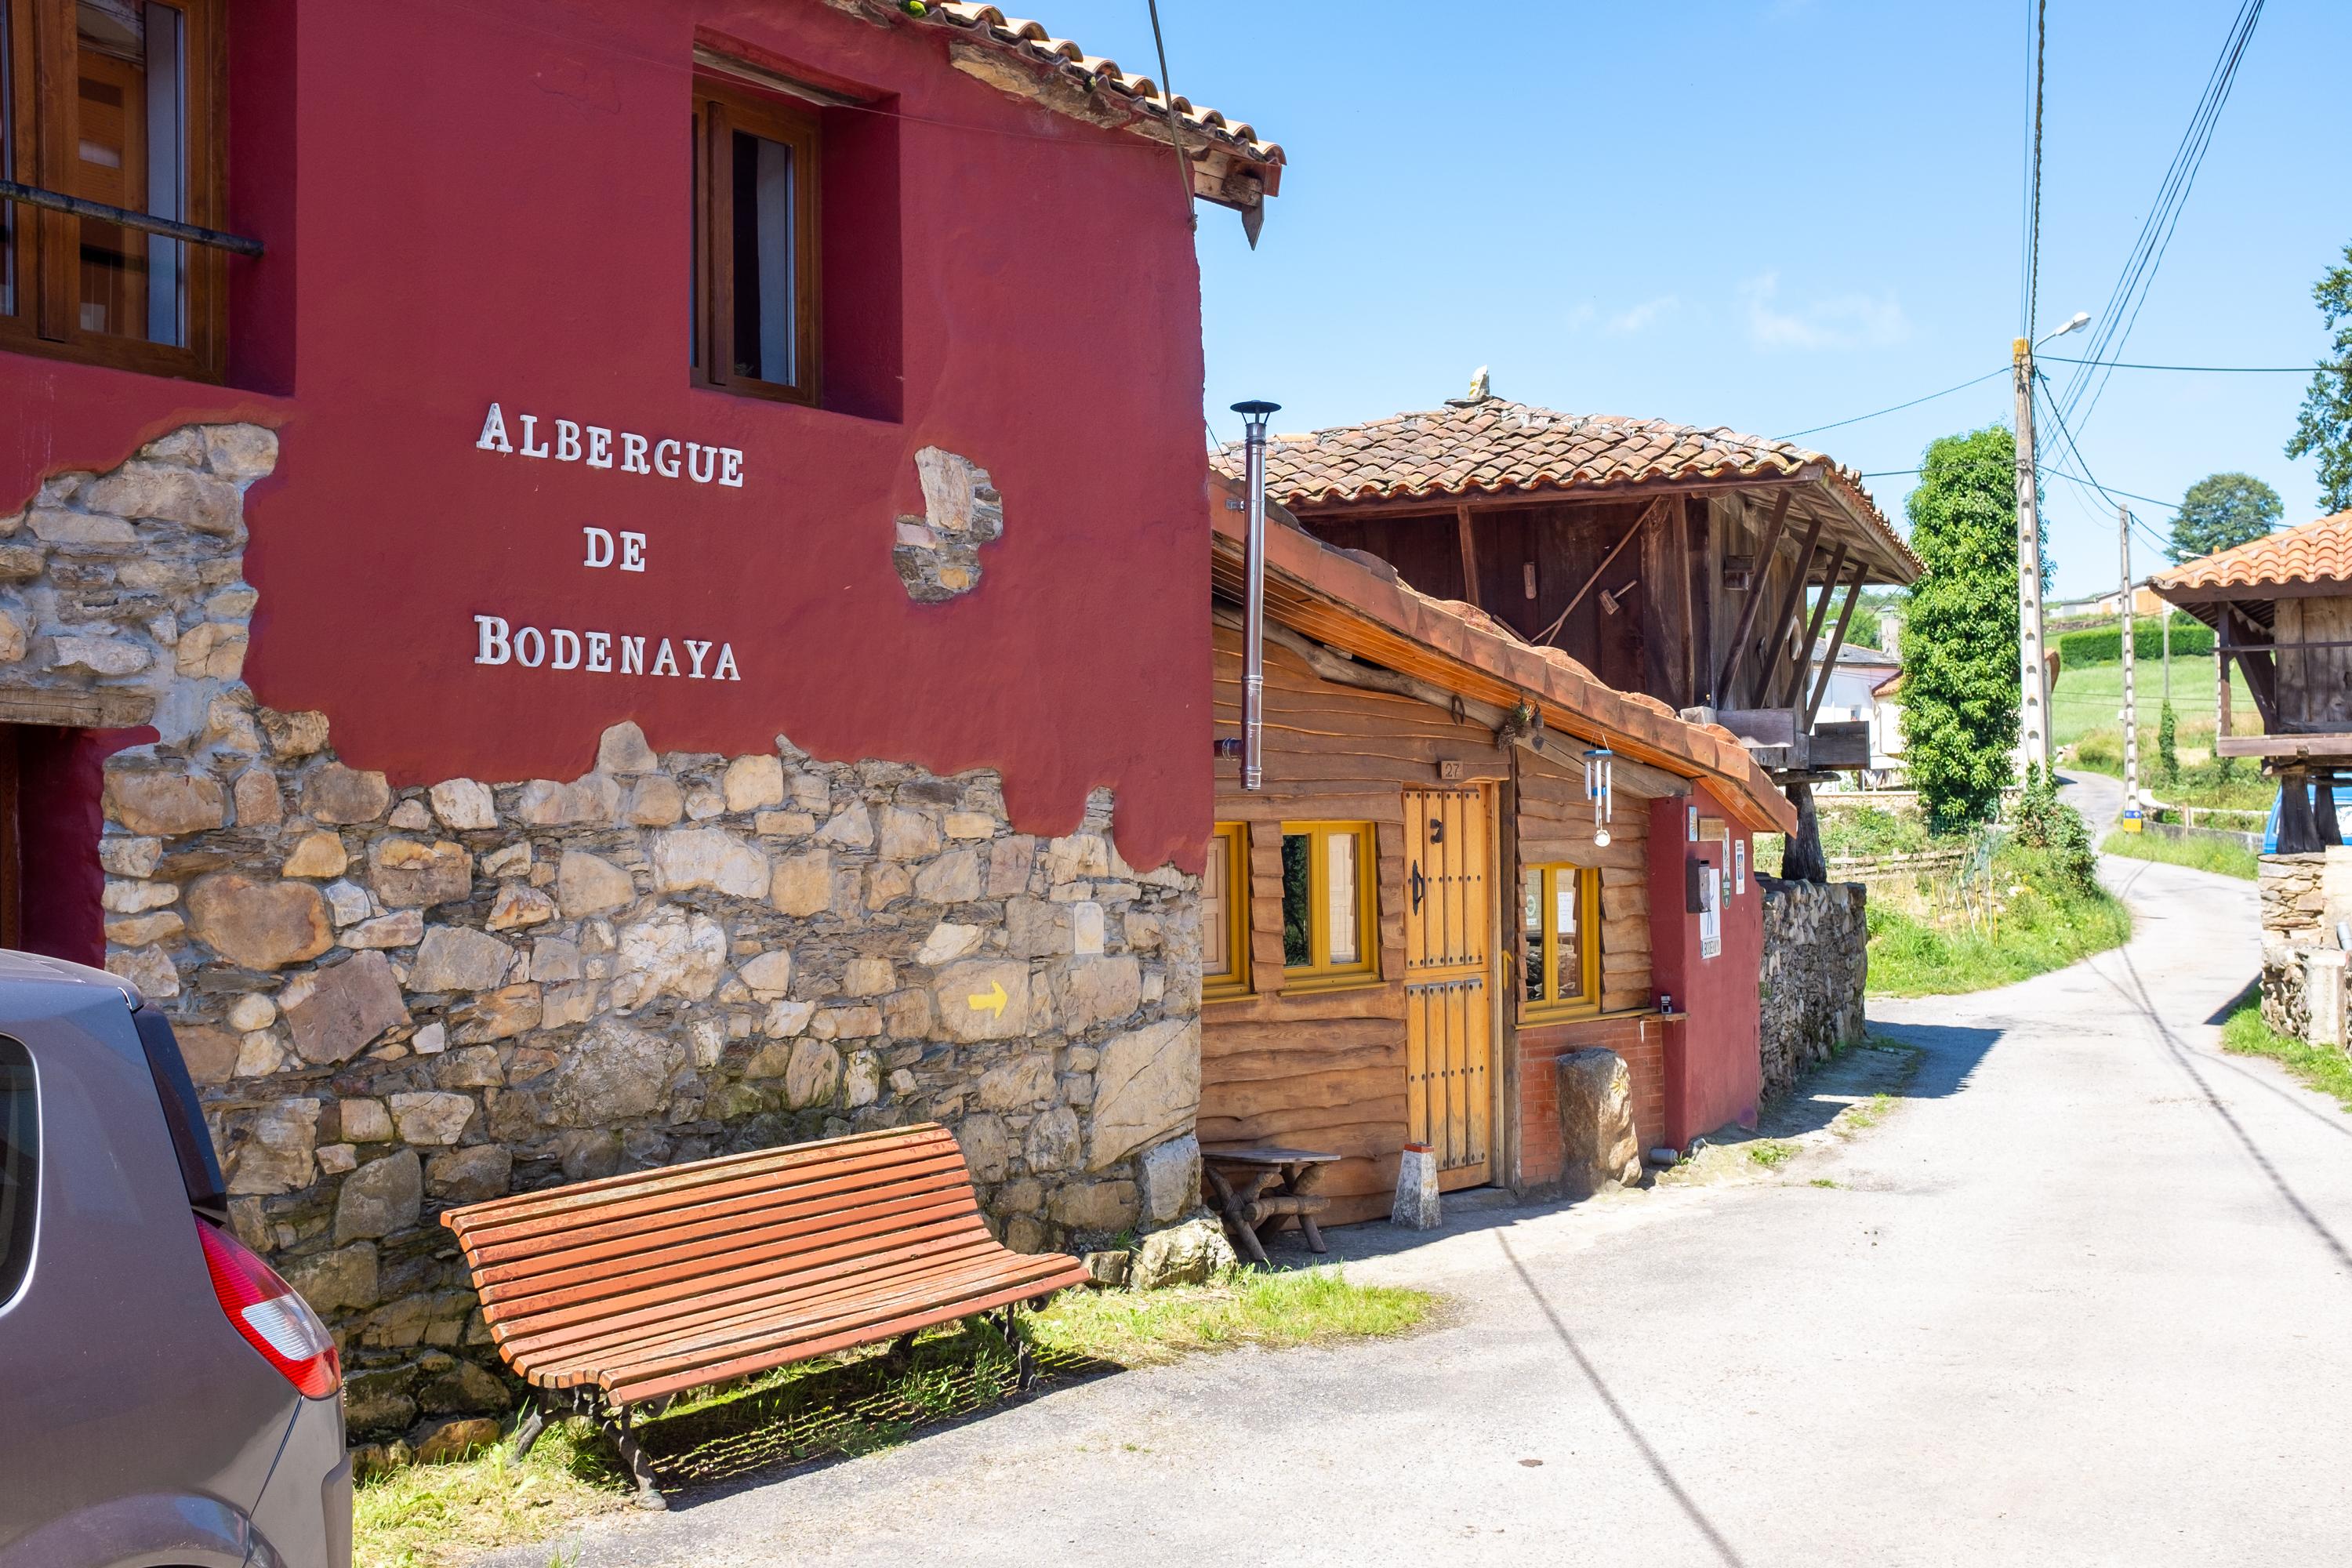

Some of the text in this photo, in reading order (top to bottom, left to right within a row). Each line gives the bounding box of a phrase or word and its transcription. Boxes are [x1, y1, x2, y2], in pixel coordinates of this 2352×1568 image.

[476, 402, 743, 488] ALBERGUE
[583, 527, 646, 572] DE
[474, 615, 741, 681] BODENAYA
[1445, 763, 1459, 777] 27
